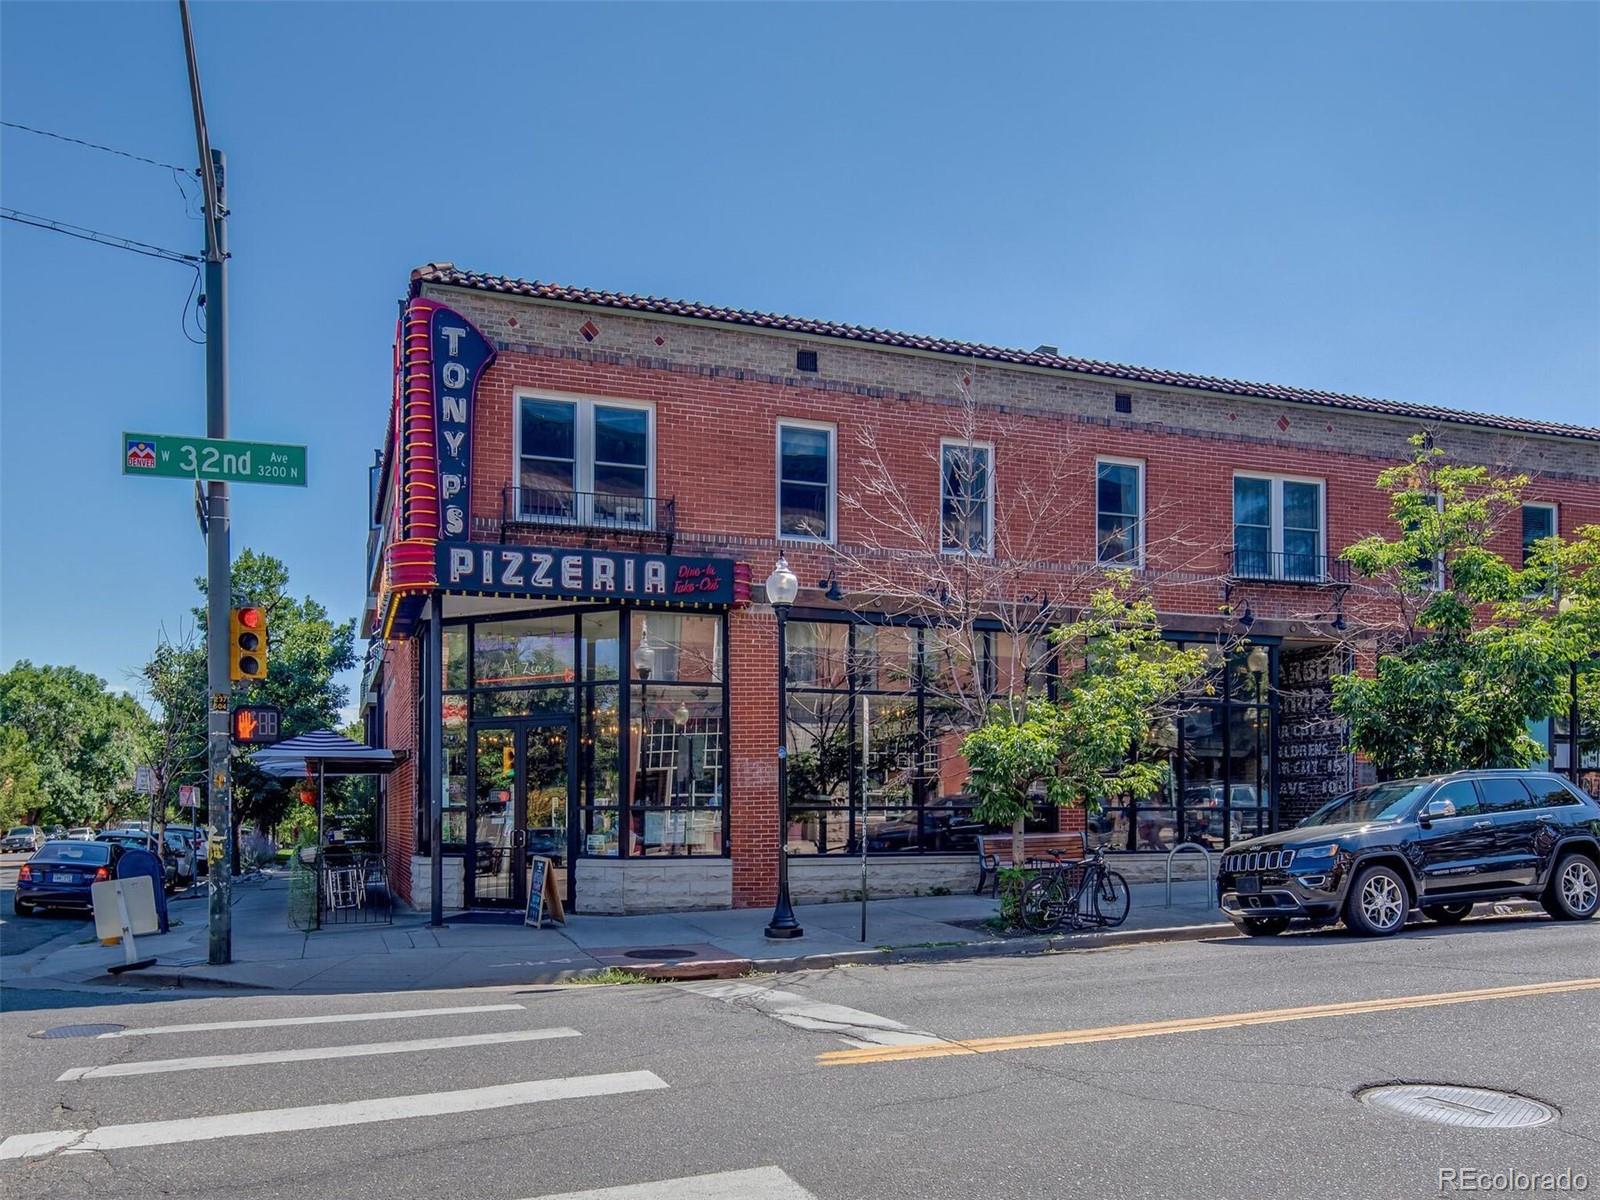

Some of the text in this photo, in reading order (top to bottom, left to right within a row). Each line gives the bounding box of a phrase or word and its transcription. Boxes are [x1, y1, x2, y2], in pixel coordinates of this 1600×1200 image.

[127, 457, 156, 467] DENVER
[161, 445, 288, 475] W 32nd Ave
[257, 465, 298, 478] 3200 N
[449, 548, 667, 594] PIZZERIA
